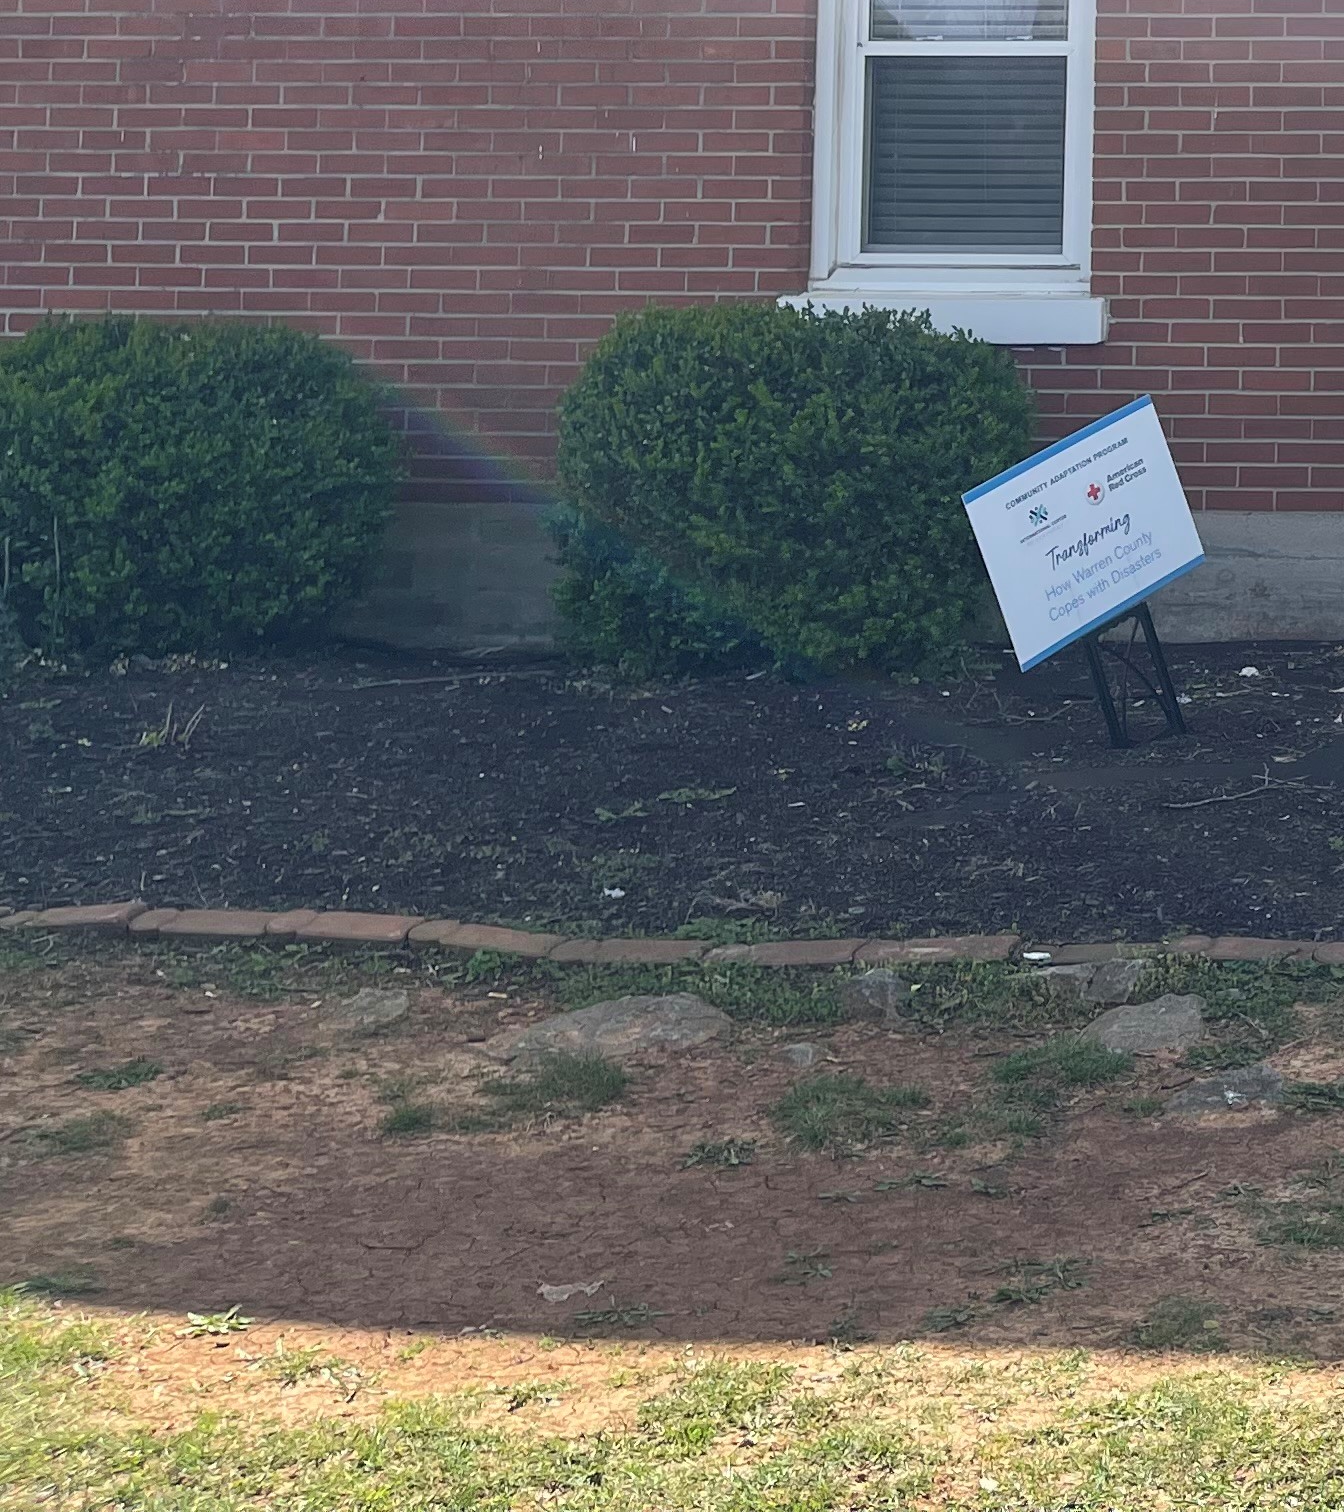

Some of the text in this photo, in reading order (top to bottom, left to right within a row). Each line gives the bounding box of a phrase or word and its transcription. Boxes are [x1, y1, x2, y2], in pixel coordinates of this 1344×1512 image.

[1005, 437, 1129, 510] COMMUNITY ADAPTATION PROGRAM
[1106, 458, 1144, 483] American
[1108, 467, 1147, 492] Red Cross
[1044, 531, 1152, 601] How Warren County
[1045, 513, 1131, 571] Transforming
[1048, 548, 1162, 622] Copes with Disasters
